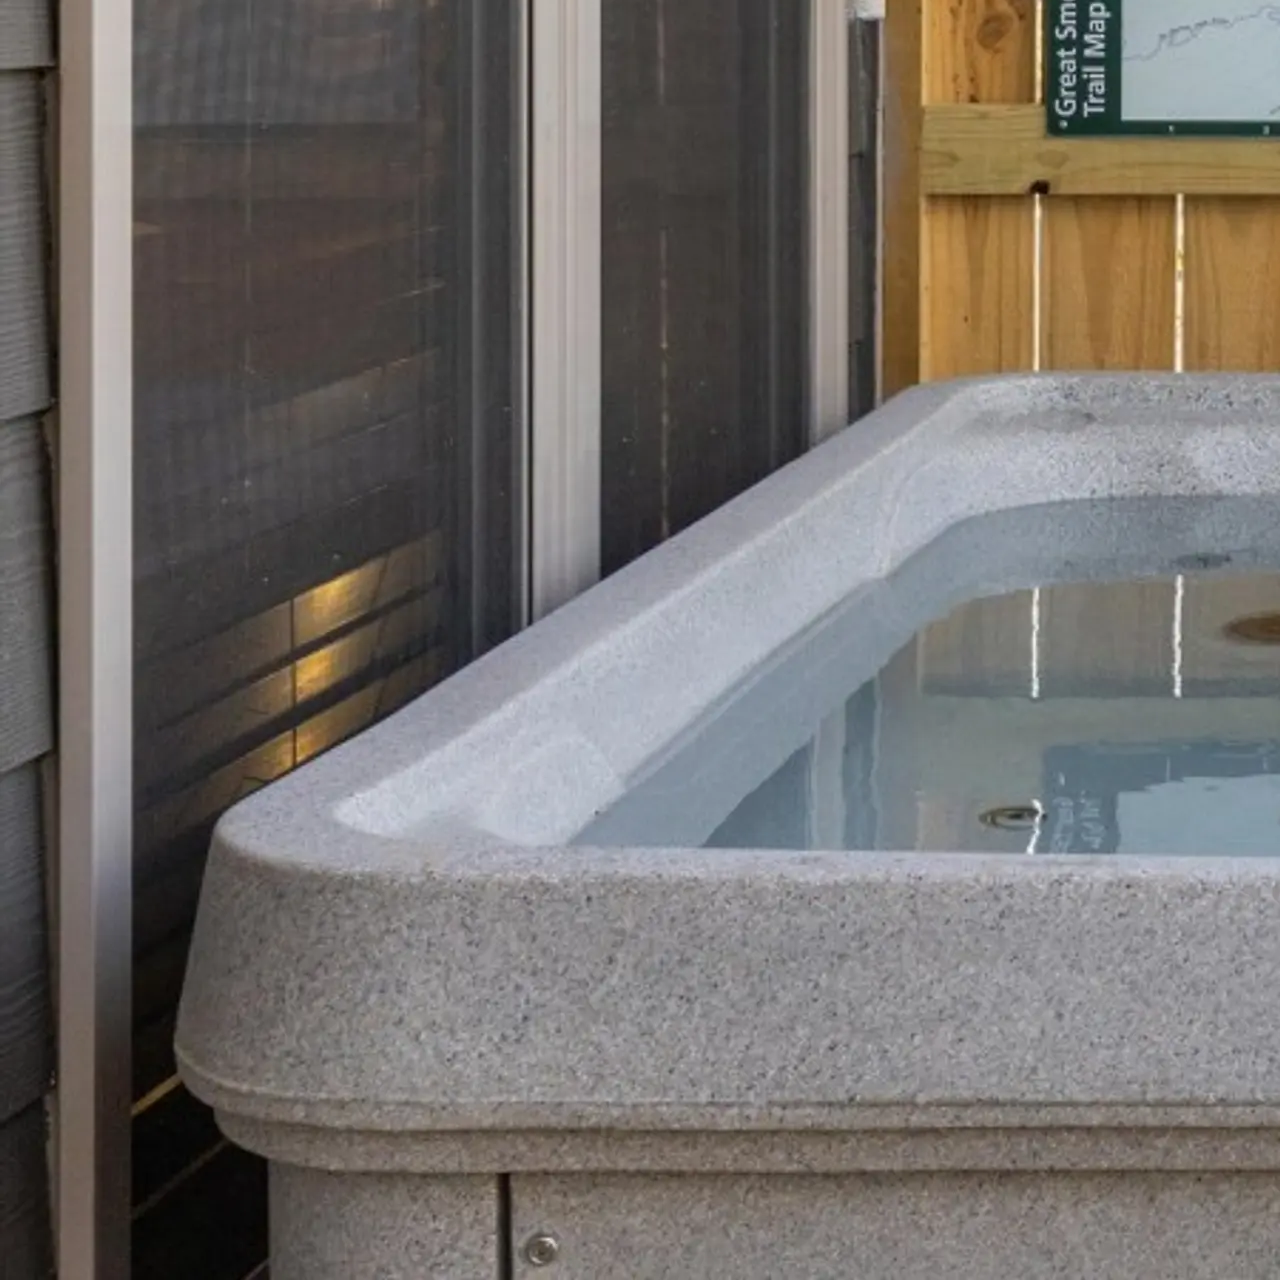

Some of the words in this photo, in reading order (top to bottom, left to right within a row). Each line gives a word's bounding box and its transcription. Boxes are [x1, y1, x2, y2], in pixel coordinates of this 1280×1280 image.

[1083, 2, 1111, 58] Map
[1054, 47, 1078, 117] Great
[1083, 66, 1106, 118] Trail
